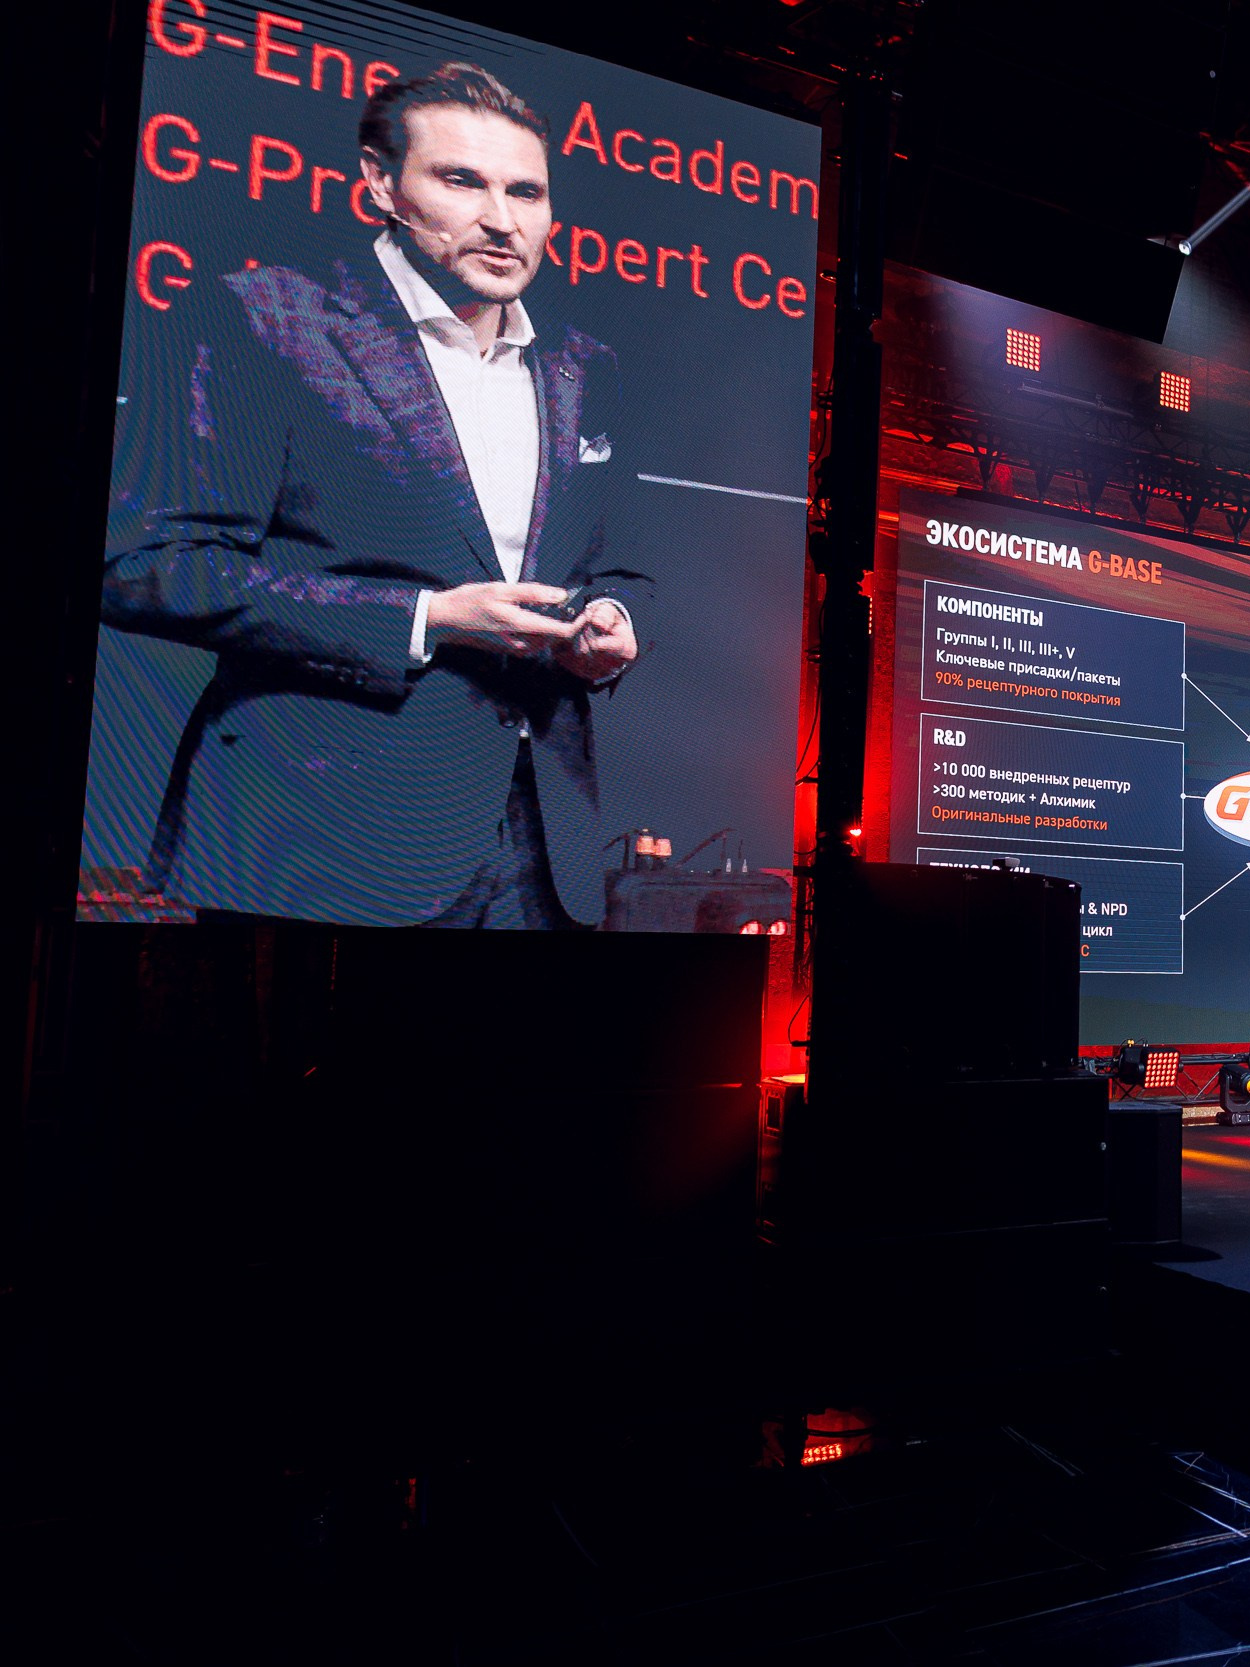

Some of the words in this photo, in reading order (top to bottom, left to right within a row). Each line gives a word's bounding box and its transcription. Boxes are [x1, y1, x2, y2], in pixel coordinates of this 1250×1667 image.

[149, 0, 400, 100] G-Ene
[545, 221, 710, 298] xpert
[926, 519, 1083, 571] ЭКОСИСТЕМА
[1088, 550, 1163, 585] G-BASE
[937, 595, 1043, 627] КОМПОНЕНТЫ
[936, 628, 987, 648] Группы
[1003, 637, 1015, 653] II,
[1019, 639, 1035, 656] III,
[1039, 642, 1063, 659] III+,
[1066, 647, 1075, 659] V
[936, 649, 1005, 670] Ключевые
[1008, 660, 1121, 687] присадки/пакеты
[935, 671, 963, 687] 90%
[967, 677, 1058, 699] рецептурного
[1061, 688, 1121, 707] покрытия
[933, 729, 966, 747] R&D
[933, 763, 958, 776] >10
[961, 764, 986, 778] 000
[989, 769, 1069, 786] внедренных
[1073, 776, 1131, 793] рецептур
[932, 784, 966, 799] >300
[969, 789, 1025, 803] методик
[1040, 793, 1096, 809] Алхимик
[931, 806, 1031, 825] Оригинальные
[1035, 815, 1108, 831] разработки
[1088, 902, 1098, 915] &
[1101, 903, 1128, 916] NPD
[1082, 926, 1113, 938] цикл
